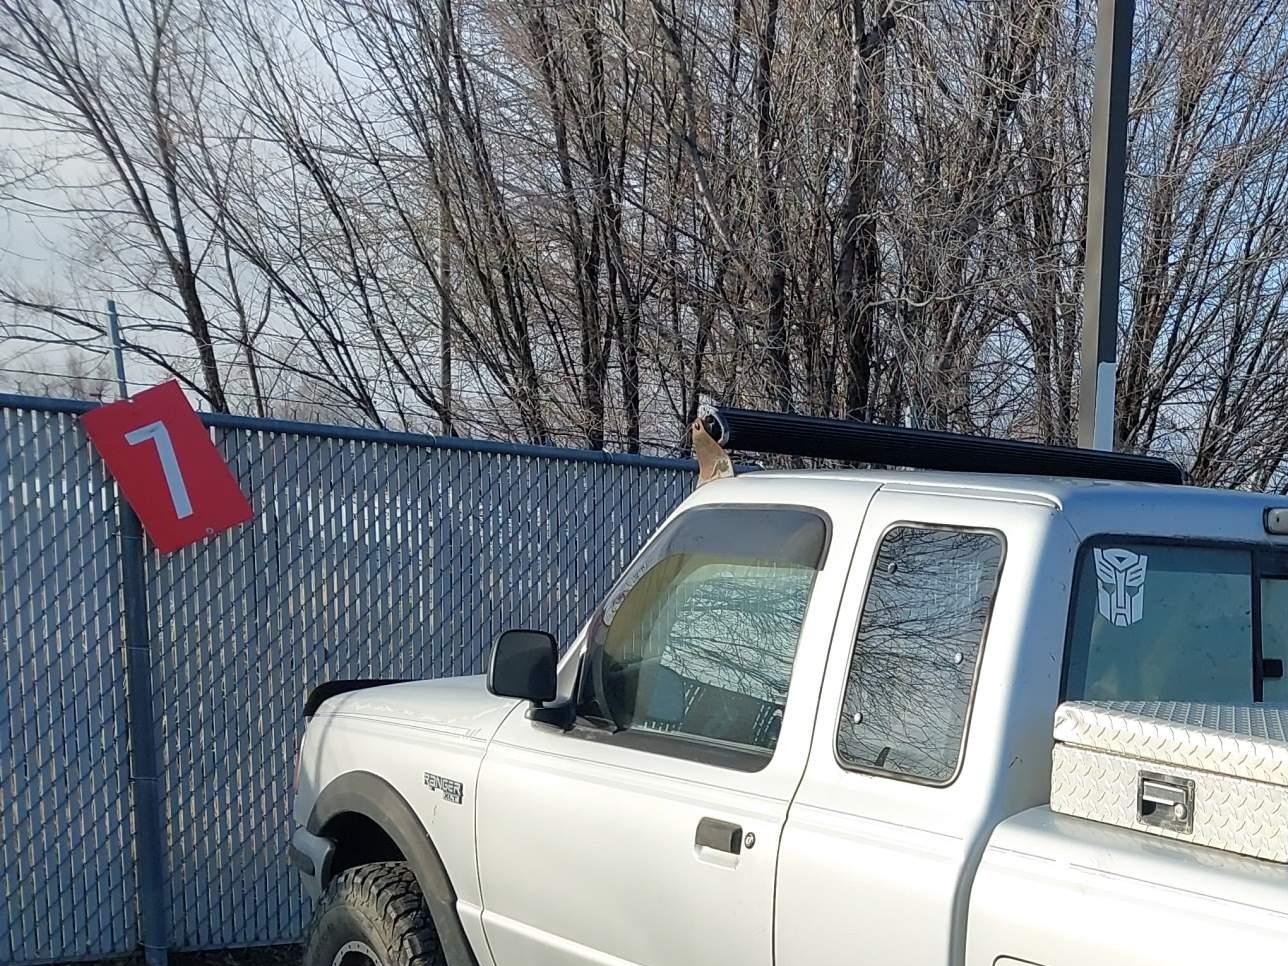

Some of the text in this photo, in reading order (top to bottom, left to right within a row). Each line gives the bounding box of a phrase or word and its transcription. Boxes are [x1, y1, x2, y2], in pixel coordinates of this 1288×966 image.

[124, 420, 193, 520] 7
[423, 771, 463, 796] RANGER
[443, 791, 462, 805] XLT
